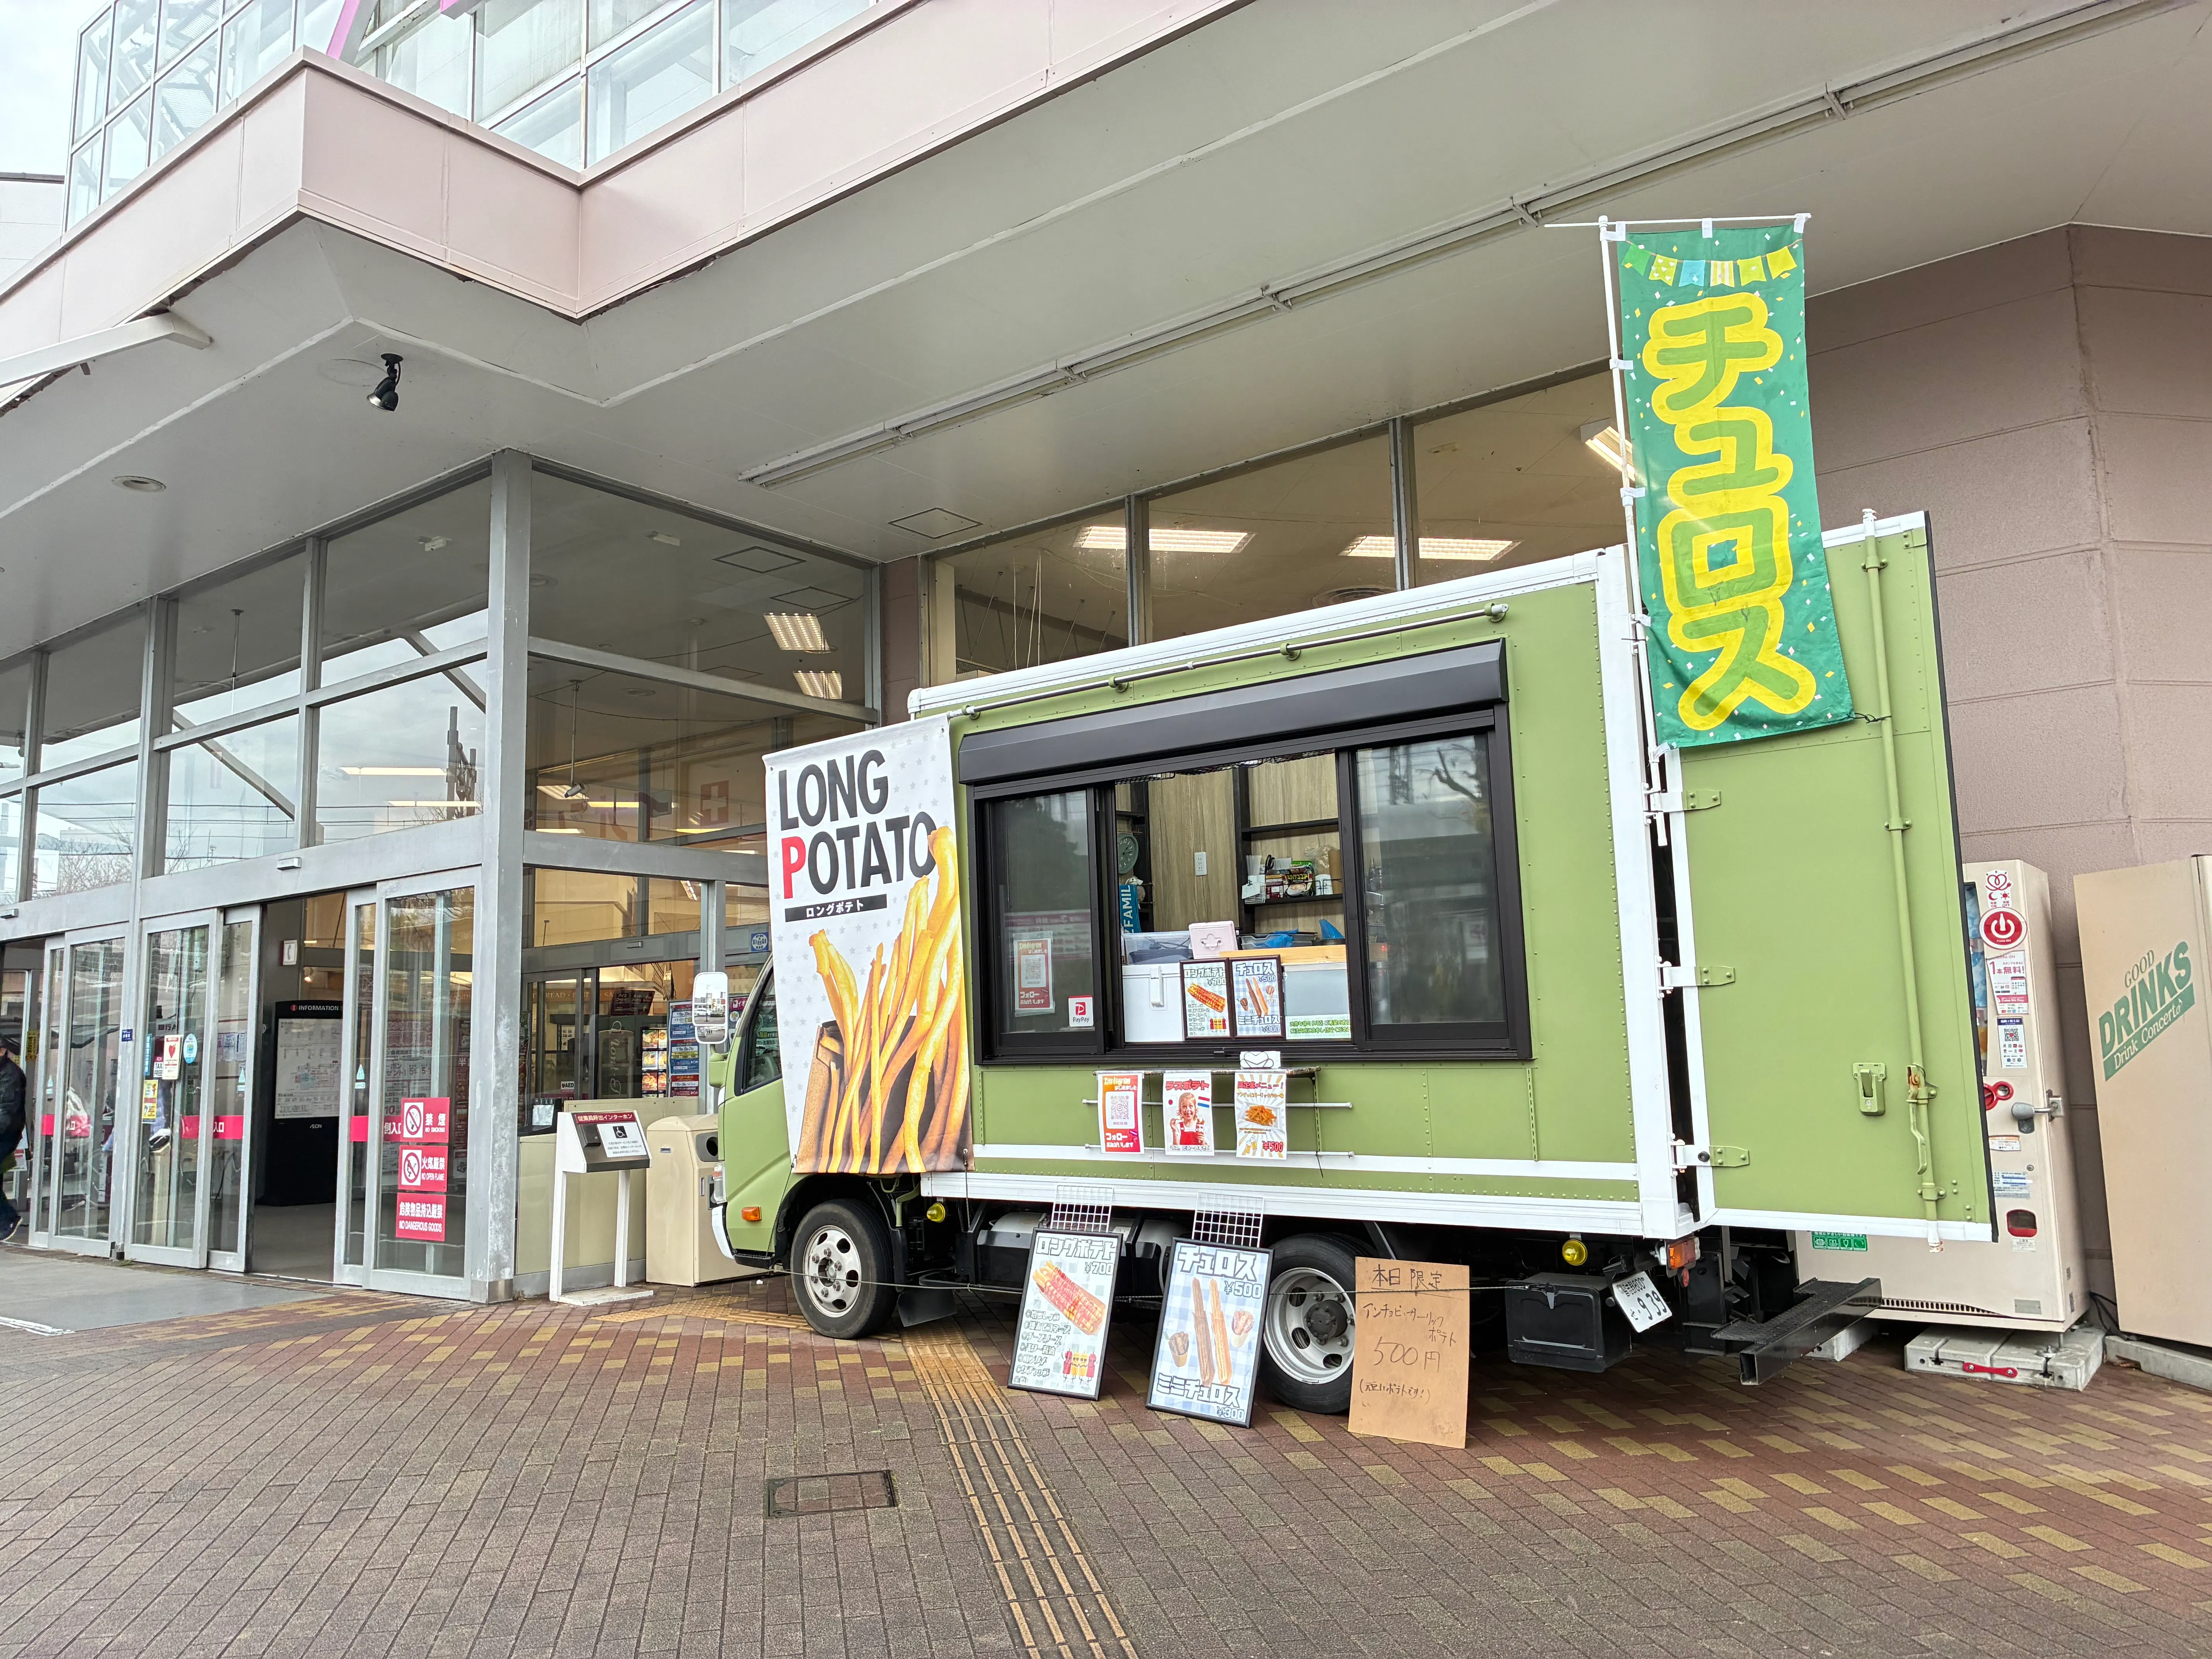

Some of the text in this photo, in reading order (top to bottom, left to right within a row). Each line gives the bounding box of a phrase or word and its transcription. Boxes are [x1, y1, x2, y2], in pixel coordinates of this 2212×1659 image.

[1643, 292, 1816, 732] チュロス
[778, 749, 888, 831] LONG
[782, 811, 937, 899] POTATO
[806, 899, 864, 917] ロングポテト
[1184, 967, 1226, 978] ロングポテト
[1236, 962, 1274, 976] チュロス
[2125, 950, 2154, 988] GOOD
[2099, 941, 2191, 1058] DRINKS
[1238, 1015, 1280, 1025] ミニチュロス
[2114, 1000, 2181, 1069] Drink Concerto
[1262, 1140, 1283, 1152] ¥500
[422, 1157, 445, 1170] 火気厳禁
[399, 1202, 443, 1219] 危険物品持込厳禁
[399, 1220, 442, 1232] NO DANGEROUS GOODS
[1036, 1236, 1117, 1260] ロングポテト
[1084, 1261, 1114, 1275] ¥700
[1177, 1245, 1257, 1282] チュロス
[1372, 1264, 1442, 1290] 本日限定
[1224, 1281, 1262, 1299] ¥500
[1429, 1326, 1456, 1346] ポテト
[1156, 1372, 1240, 1408] ミニチュロス
[1217, 1406, 1245, 1421] ¥300
